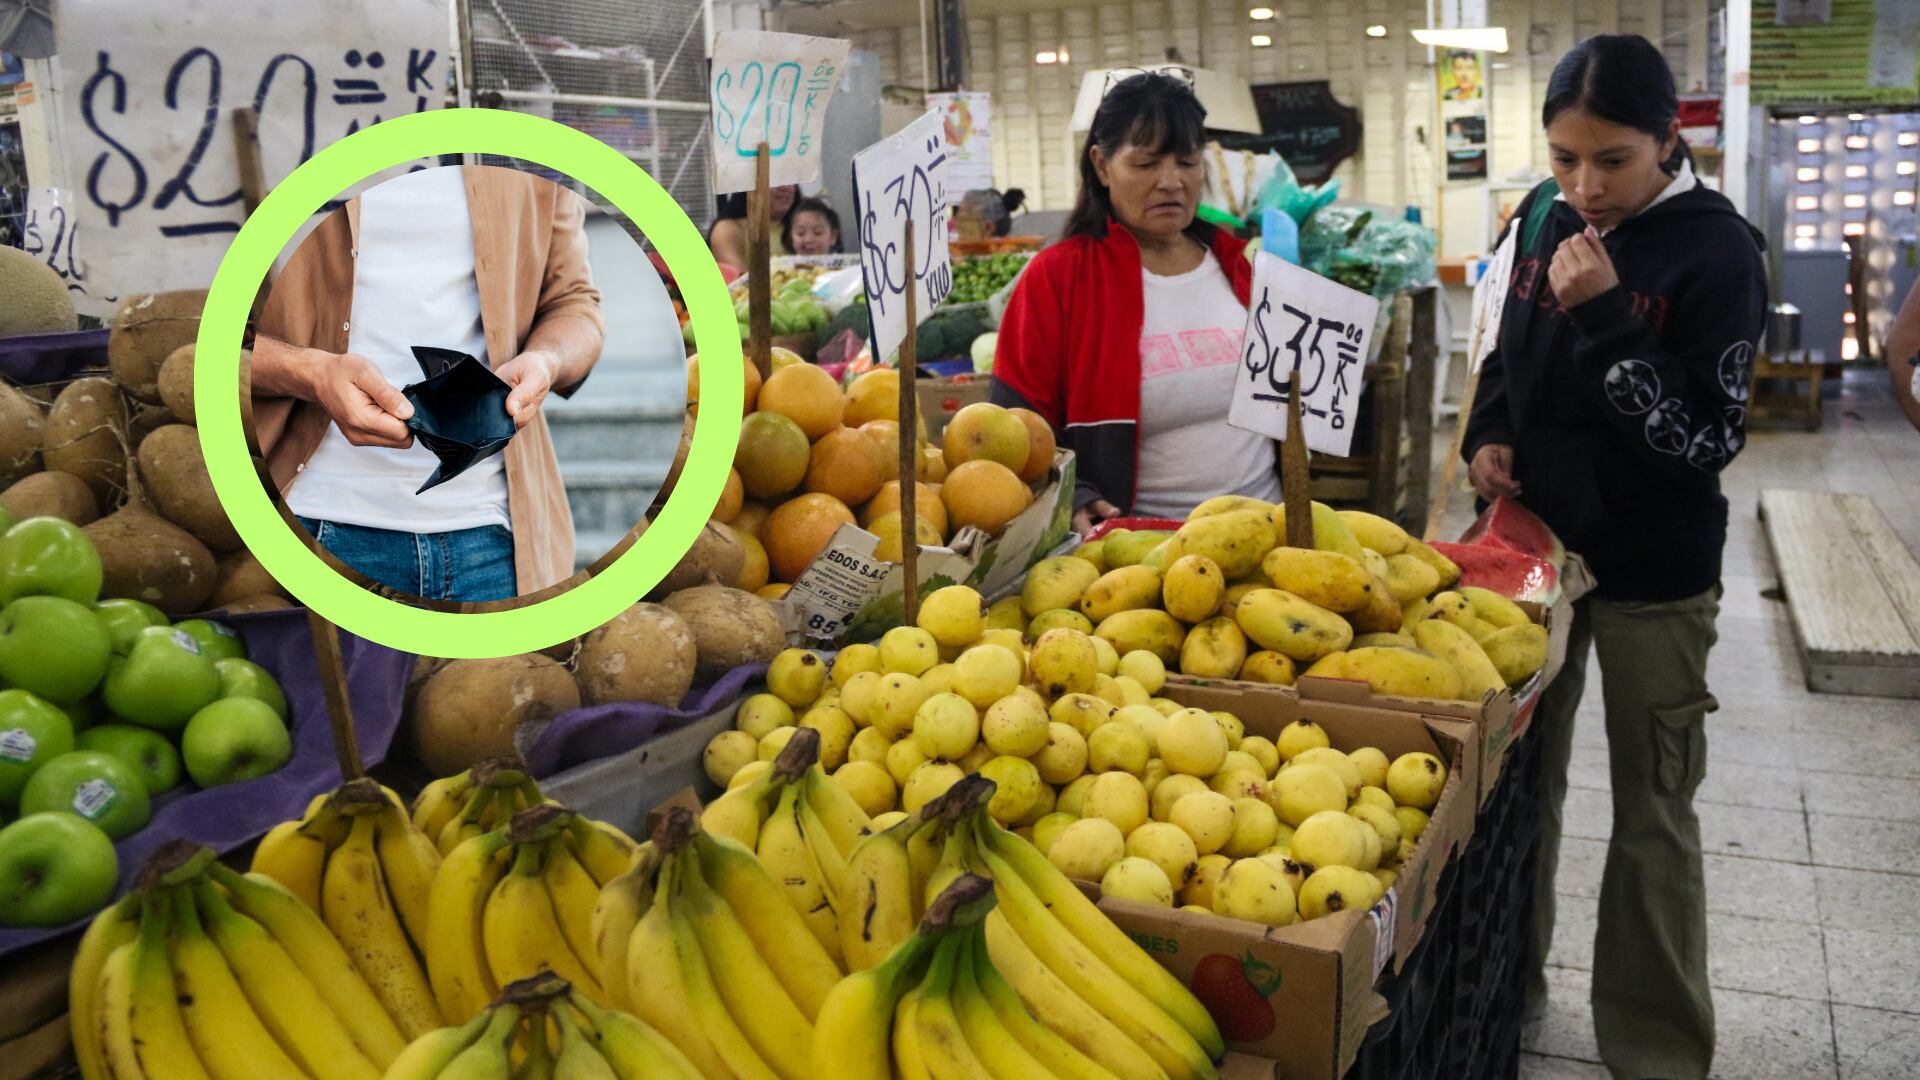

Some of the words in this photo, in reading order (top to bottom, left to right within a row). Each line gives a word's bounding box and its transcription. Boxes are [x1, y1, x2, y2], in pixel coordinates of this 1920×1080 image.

[717, 62, 800, 157] $20
[863, 164, 932, 316] $30
[1246, 287, 1345, 397] $35
[1331, 359, 1348, 430] KILO
[826, 550, 860, 571] EDOS
[808, 613, 839, 634] 85
[1132, 932, 1179, 953] SES
